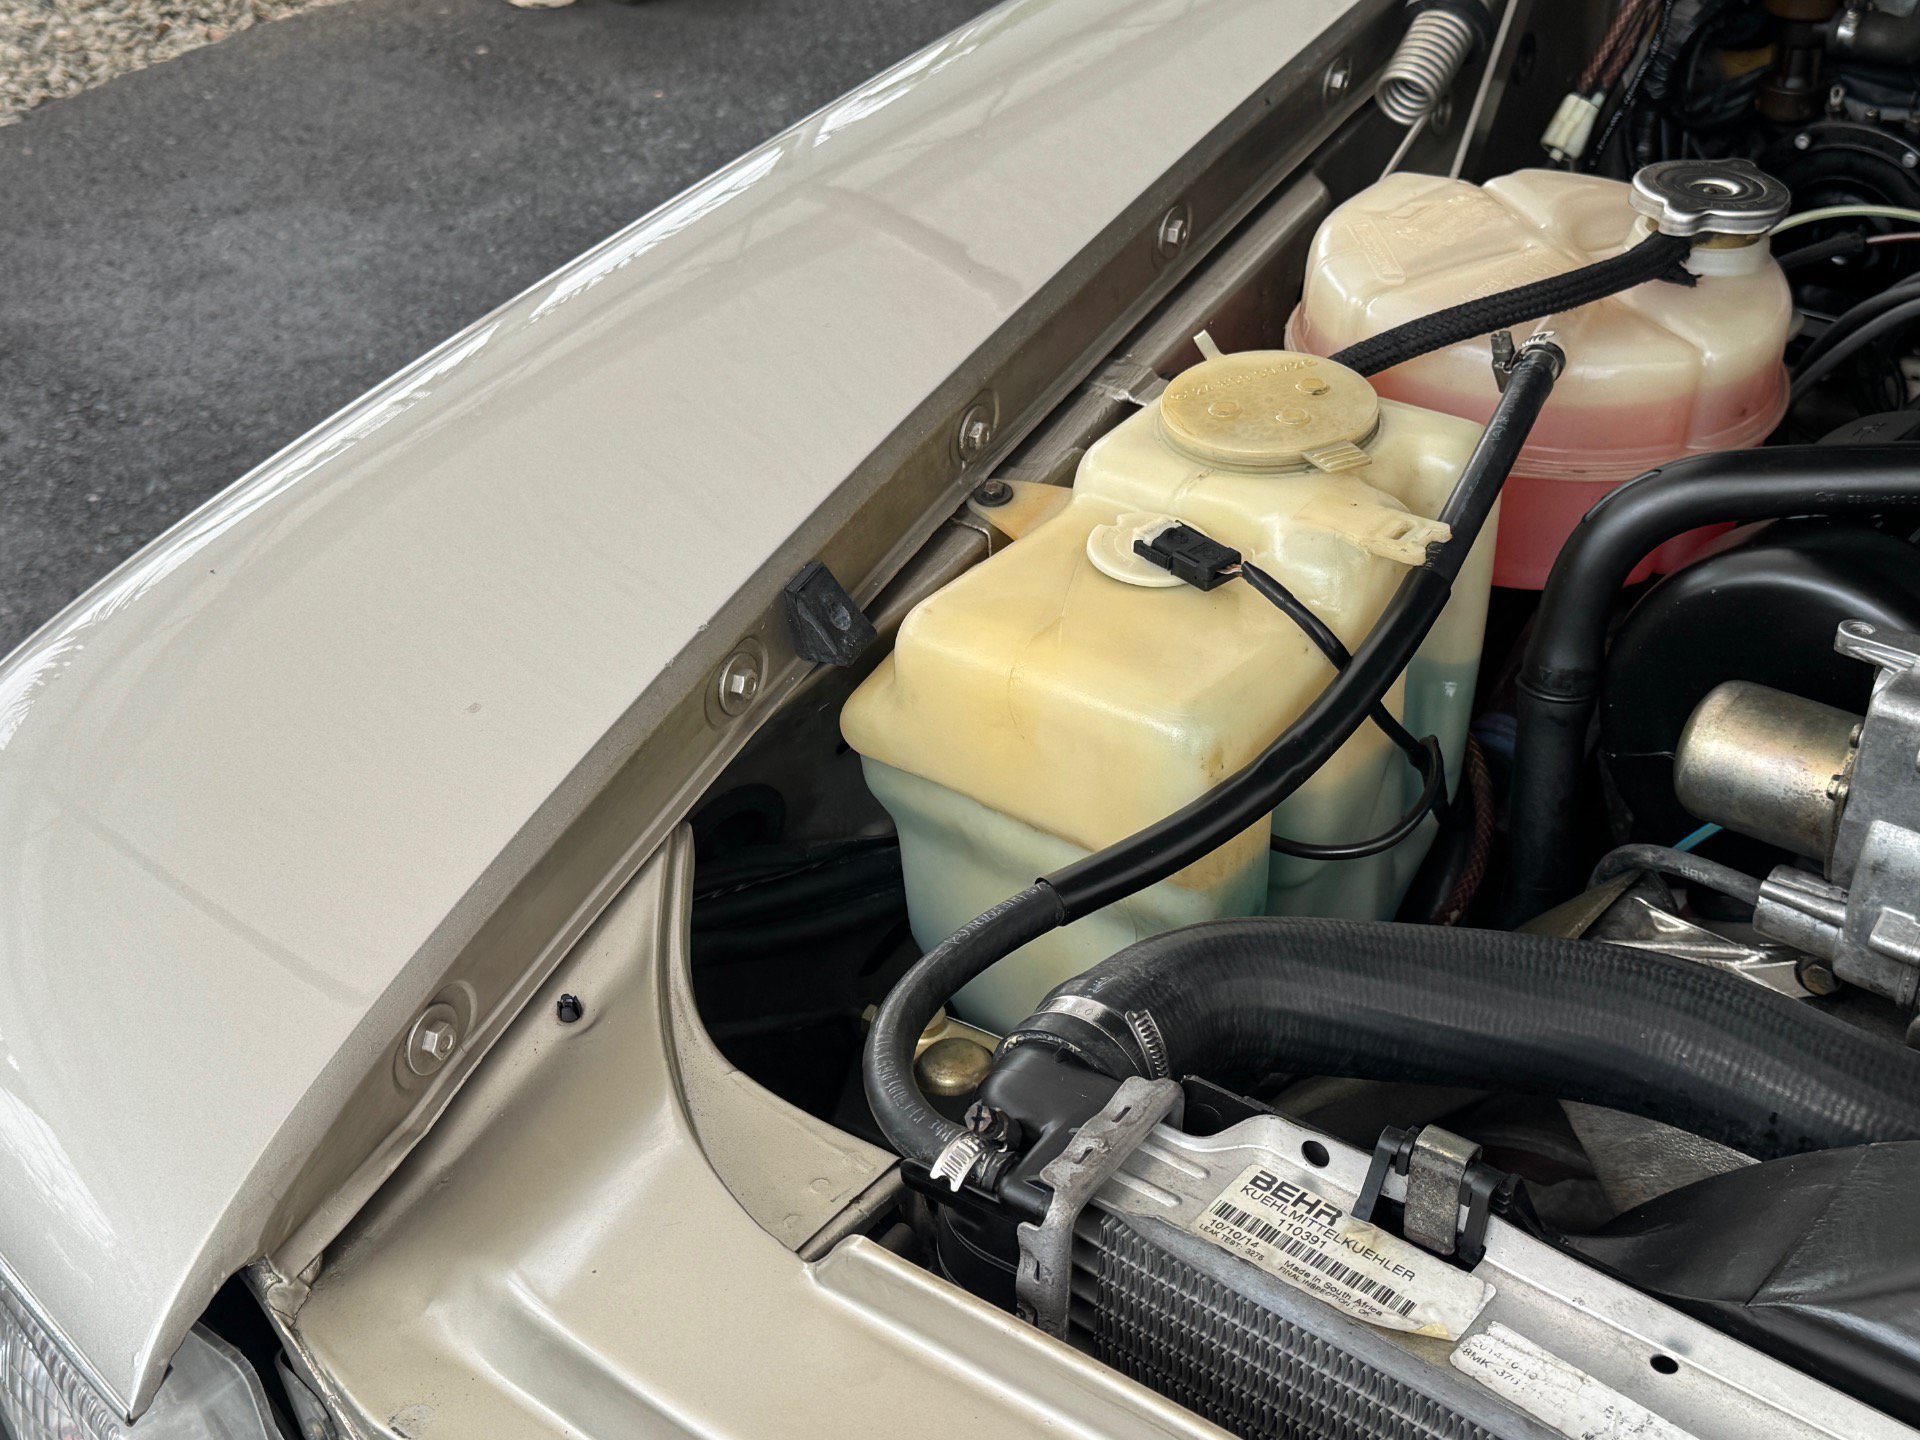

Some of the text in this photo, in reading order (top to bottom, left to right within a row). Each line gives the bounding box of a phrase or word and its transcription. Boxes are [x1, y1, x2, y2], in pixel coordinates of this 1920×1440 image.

[1249, 1170, 1342, 1227] BEHR
[1199, 1224, 1220, 1237] LEAK
[1210, 1219, 1259, 1248] 10/10/14
[1240, 1183, 1415, 1281] KUEHLMITTELKUEHLER
[1278, 1219, 1327, 1249] 110391
[1279, 1266, 1301, 1282] FINAL
[1358, 1309, 1372, 1317] OK
[1284, 1260, 1311, 1278] Made
[1324, 1282, 1351, 1300] South
[1353, 1298, 1383, 1316] Africa
